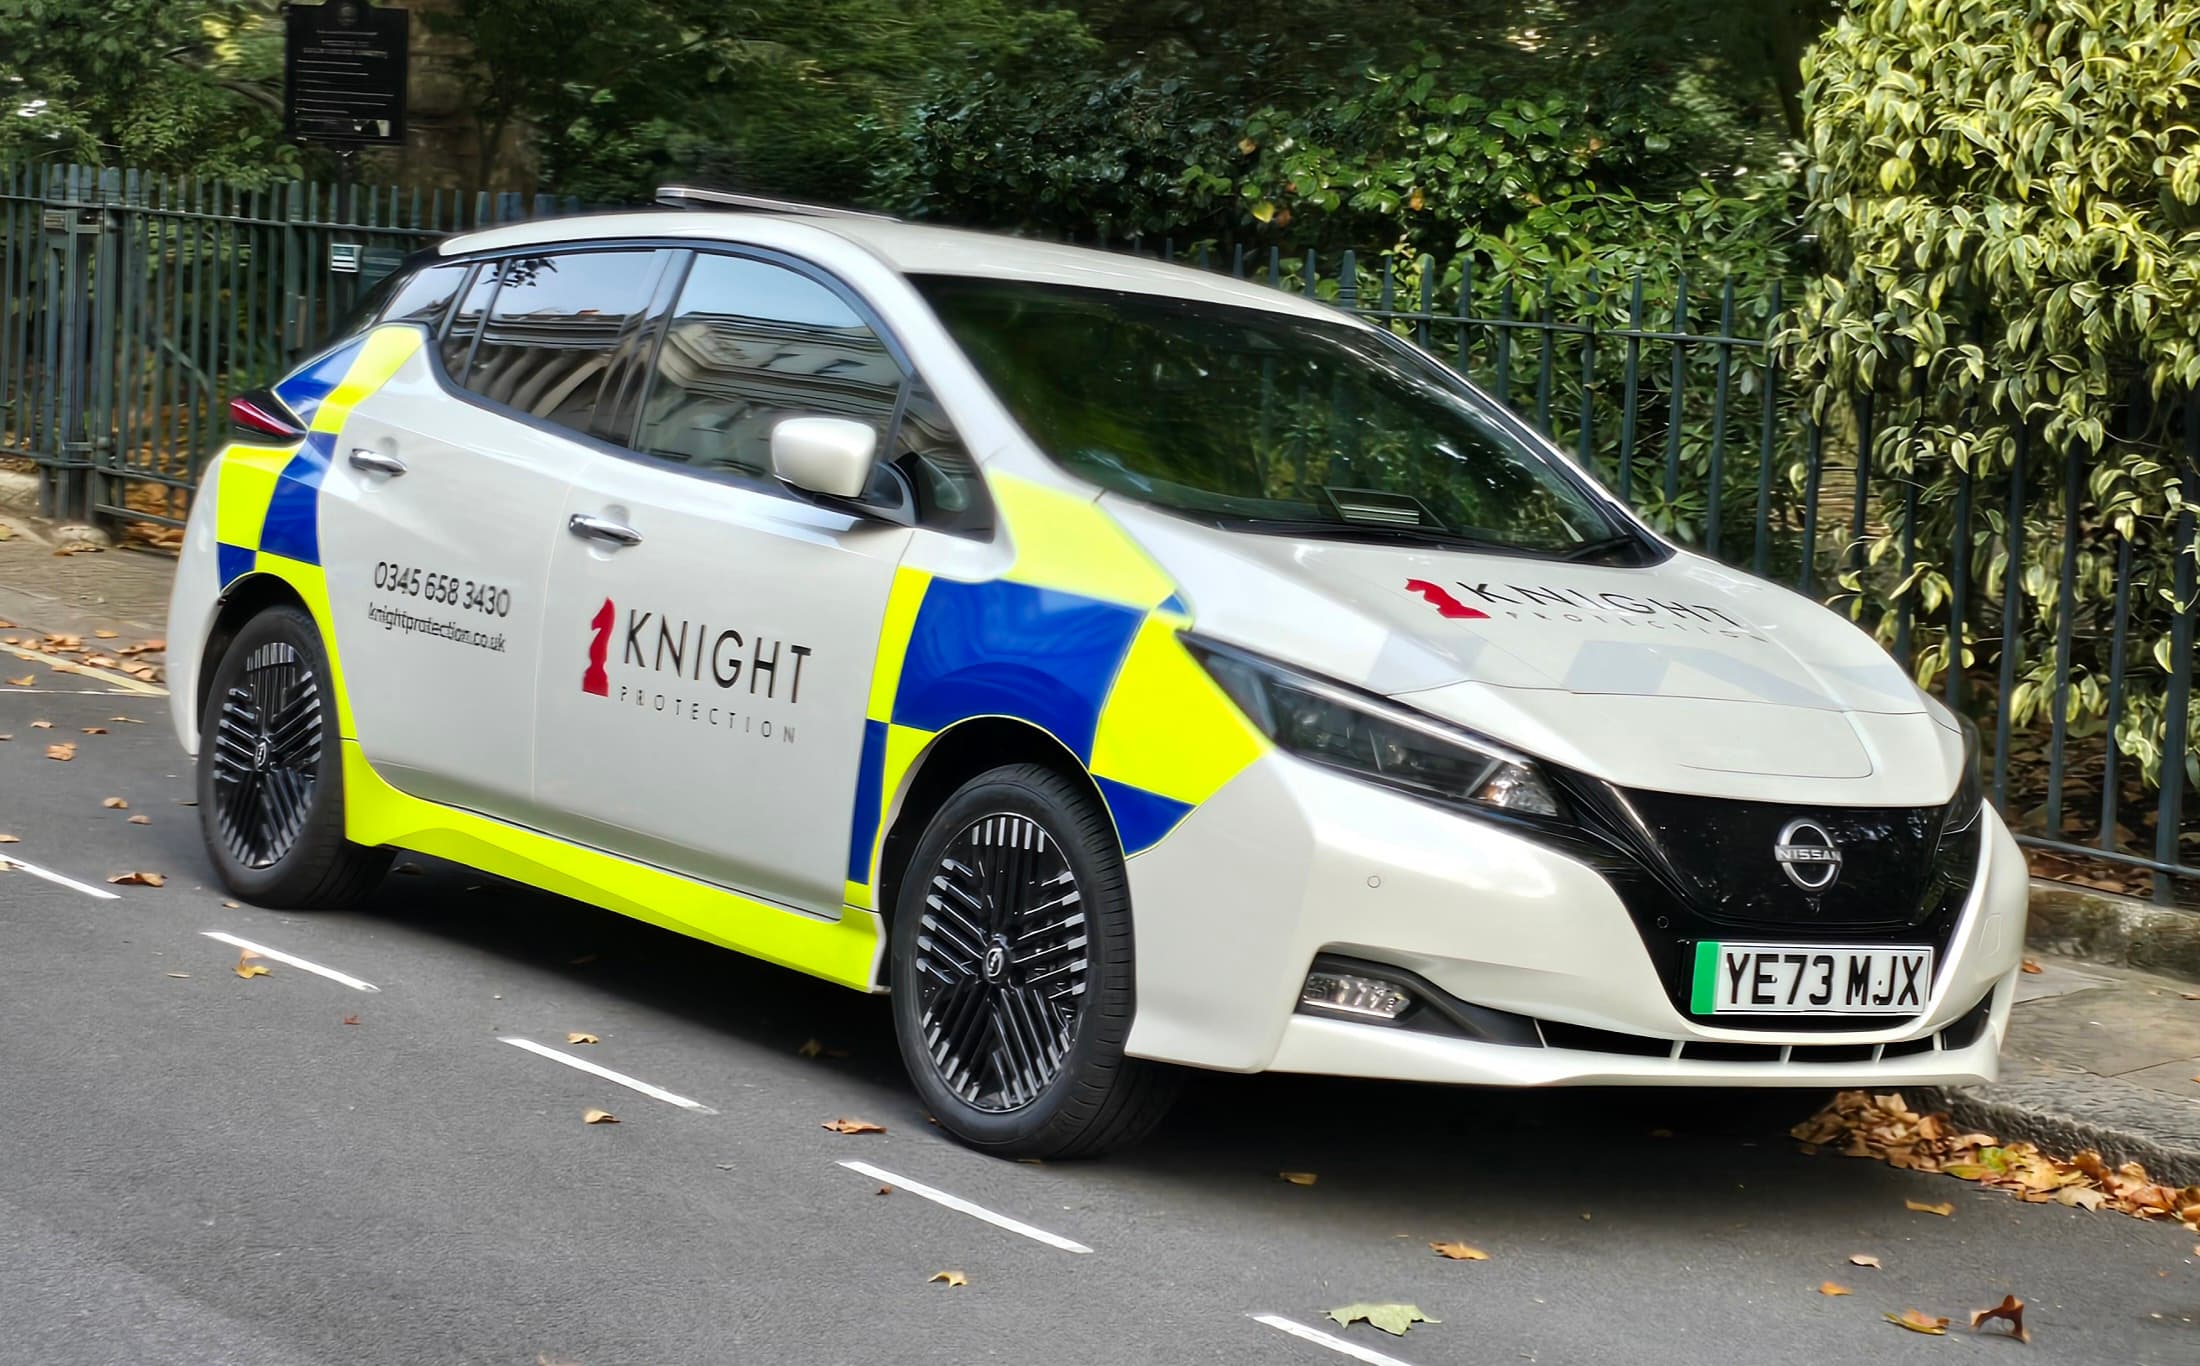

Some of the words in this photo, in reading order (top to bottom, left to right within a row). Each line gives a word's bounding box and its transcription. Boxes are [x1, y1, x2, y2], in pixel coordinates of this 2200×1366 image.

[374, 561, 422, 597] 0345
[424, 572, 460, 606] 658
[462, 580, 511, 618] 3430
[1455, 581, 1743, 628] KNIGHT
[367, 601, 506, 653] knightprotection.co.uk
[623, 608, 812, 704] KNIGHT
[619, 685, 797, 744] PROTECTION
[1779, 848, 1841, 862] NISSAN
[1726, 952, 1835, 1006] YE73
[1845, 954, 1924, 1006] MJX
